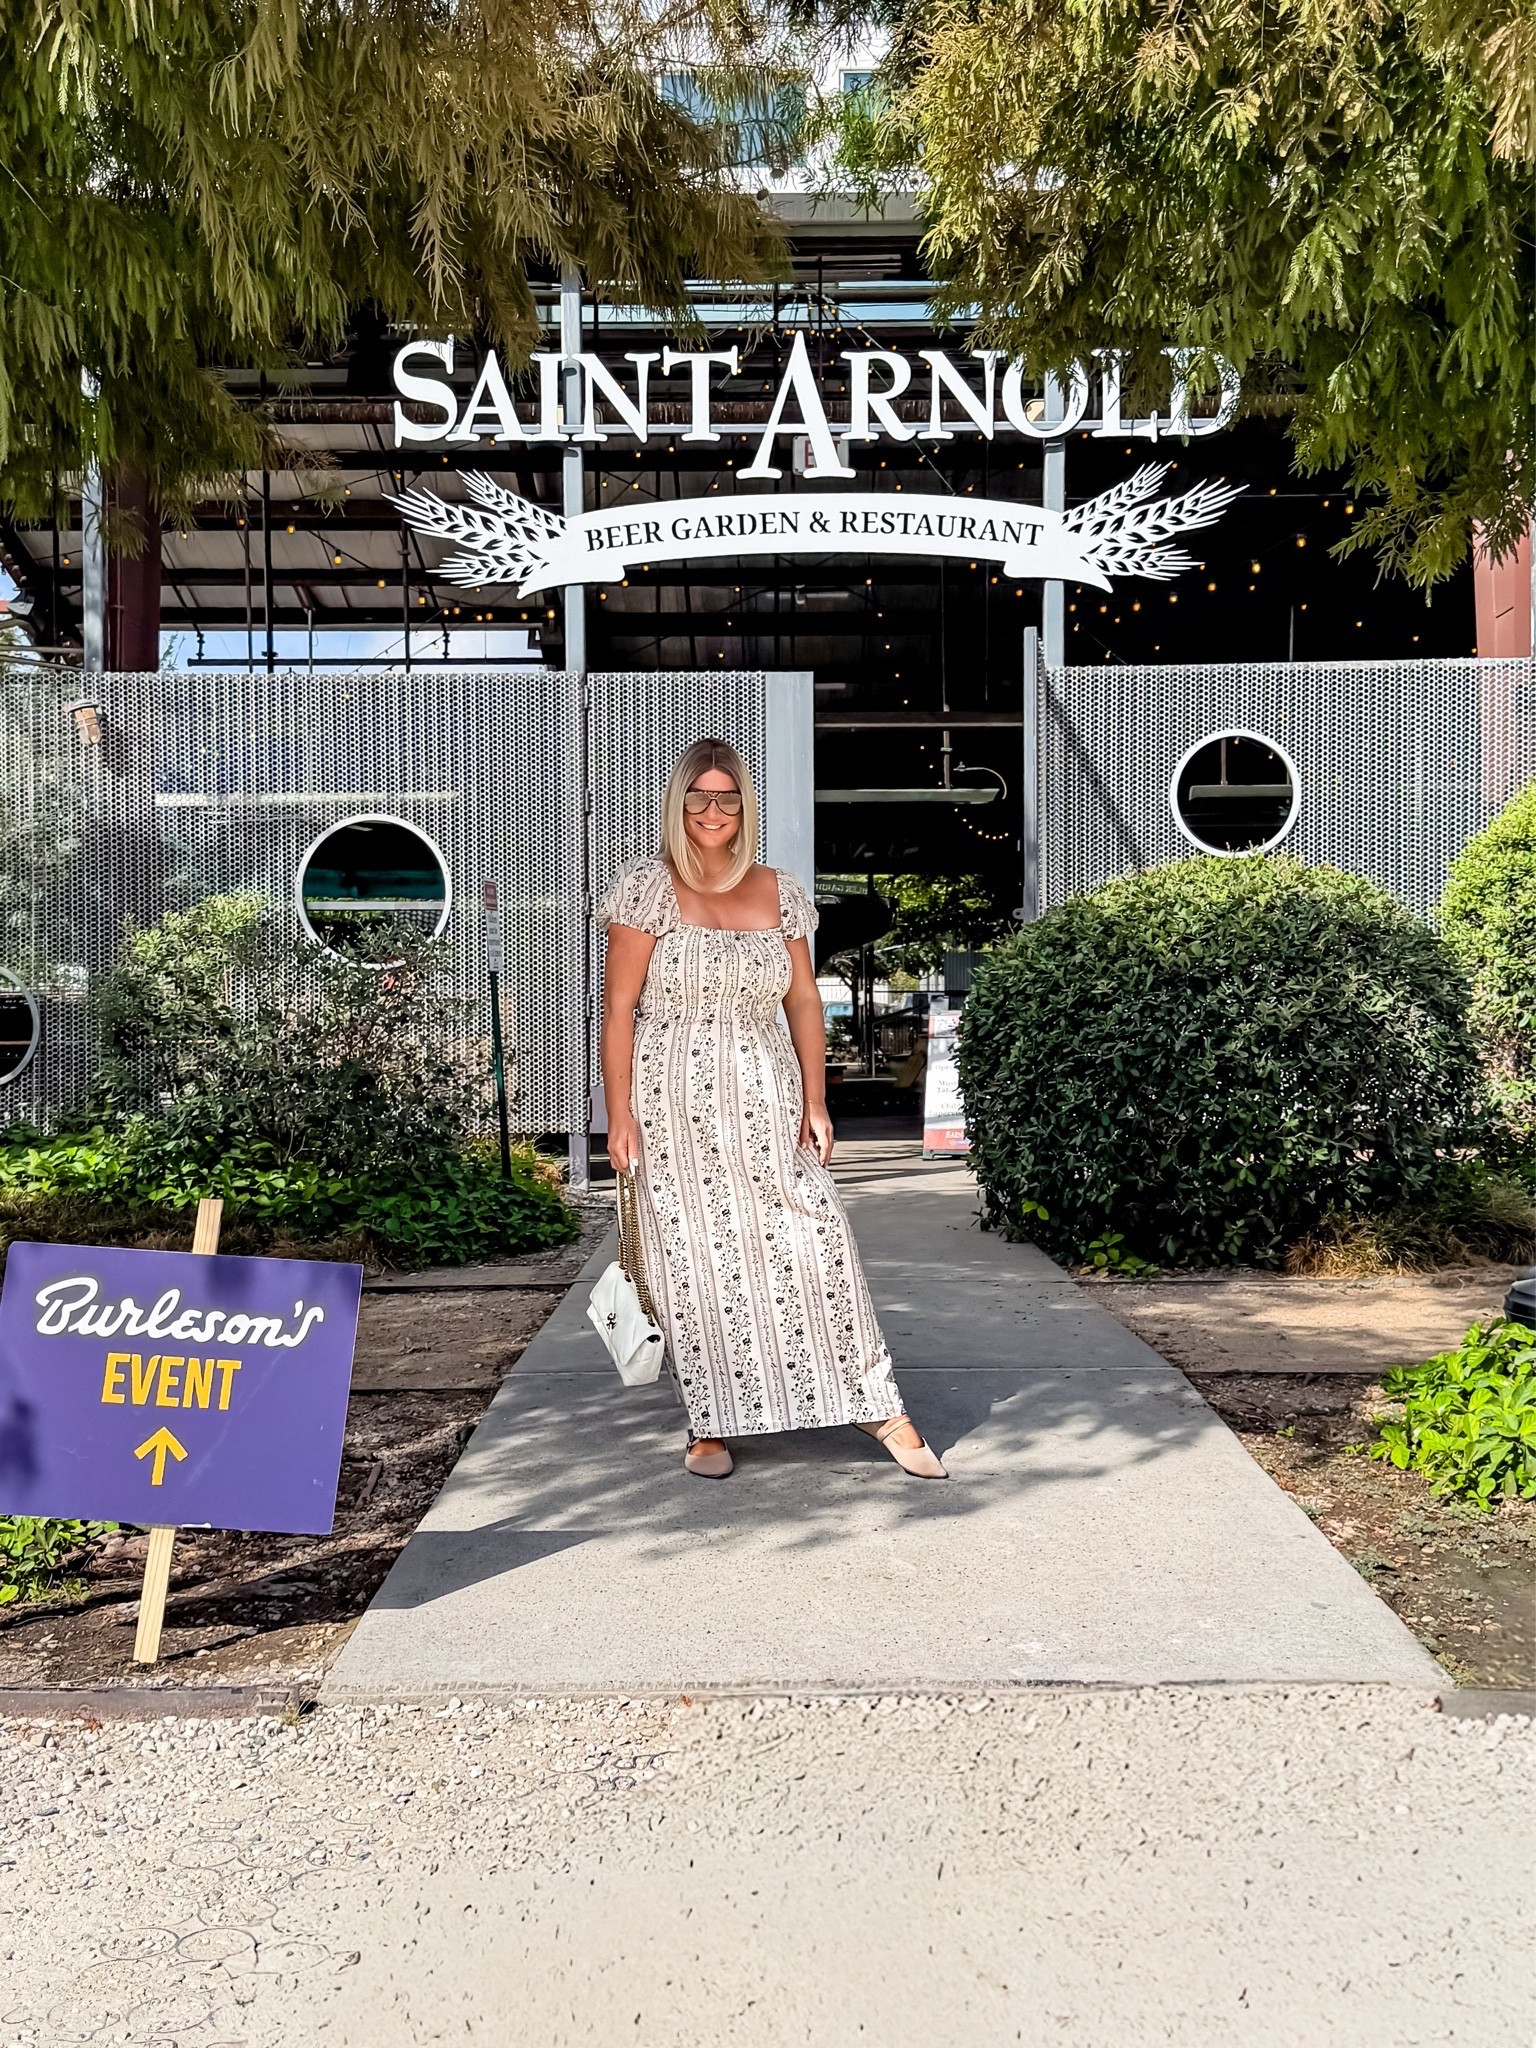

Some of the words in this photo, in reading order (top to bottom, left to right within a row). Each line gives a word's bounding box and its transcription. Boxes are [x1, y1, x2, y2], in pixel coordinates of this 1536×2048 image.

[393, 334, 738, 447] SAINT
[736, 331, 1241, 480] ARNOLD
[584, 519, 664, 552] BEER
[671, 511, 800, 540] GARDEN
[809, 510, 831, 533] &
[839, 511, 1044, 547] RESTAURANT
[36, 1277, 324, 1347] Burleson's
[101, 1353, 242, 1410] EVENT
